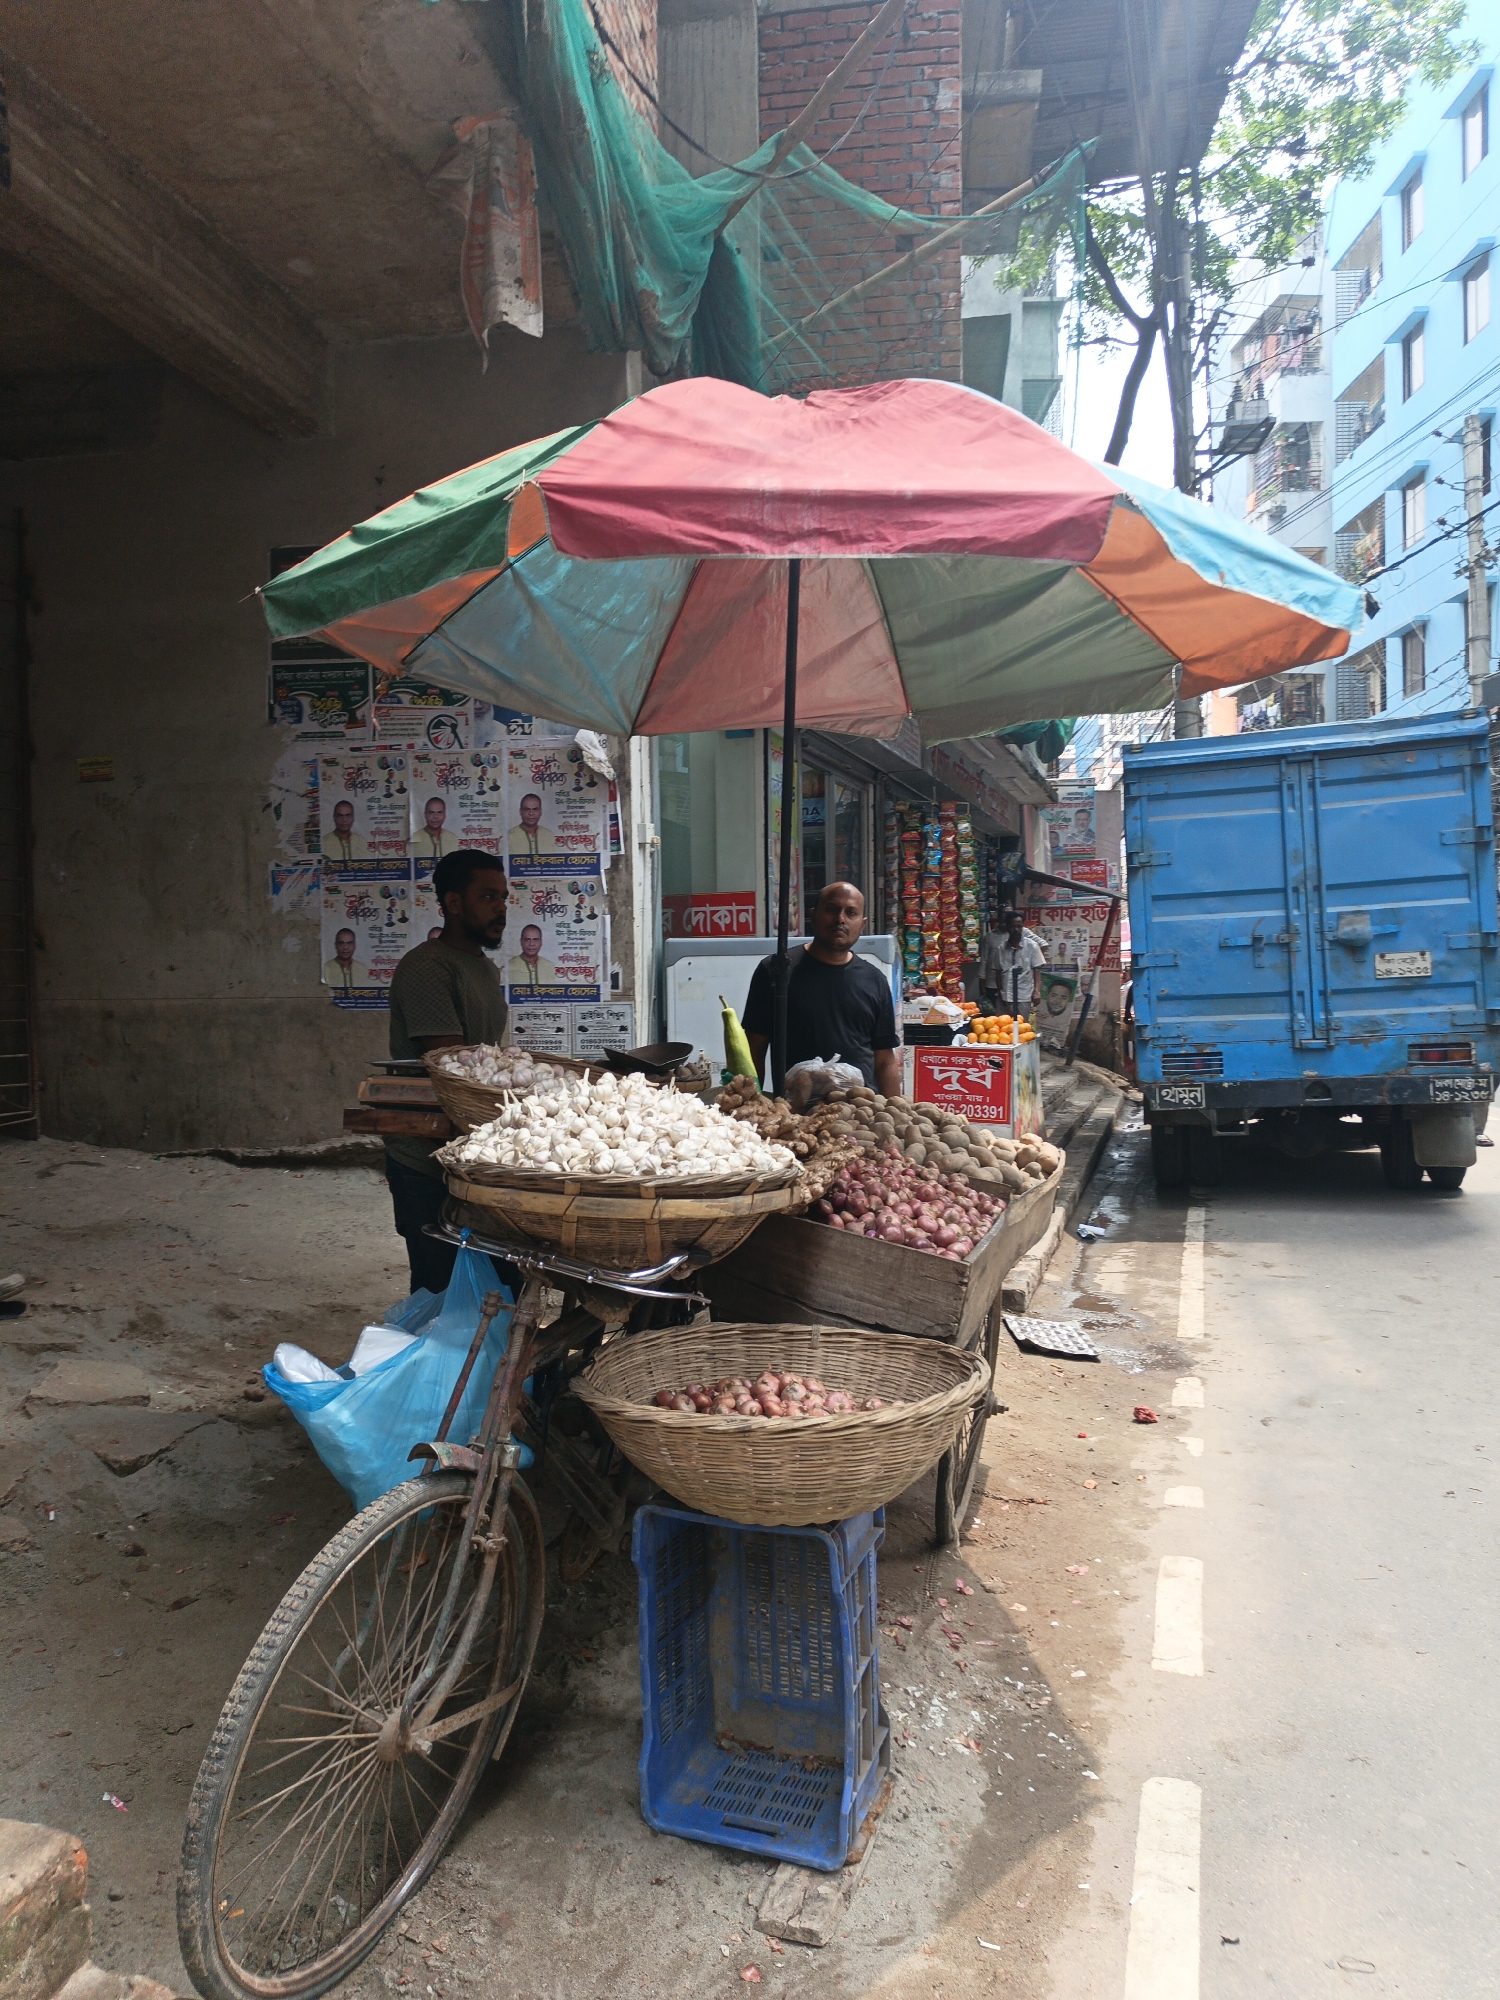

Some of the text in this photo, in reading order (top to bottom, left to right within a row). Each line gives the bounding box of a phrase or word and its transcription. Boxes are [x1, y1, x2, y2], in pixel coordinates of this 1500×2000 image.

[683, 902, 755, 934] দোকান
[921, 1055, 949, 1065] এখানে
[951, 1055, 973, 1065] গরুর
[925, 1065, 1000, 1094] দুধ
[933, 1093, 963, 1101] পাওয়া
[1161, 1086, 1202, 1106] থামুন
